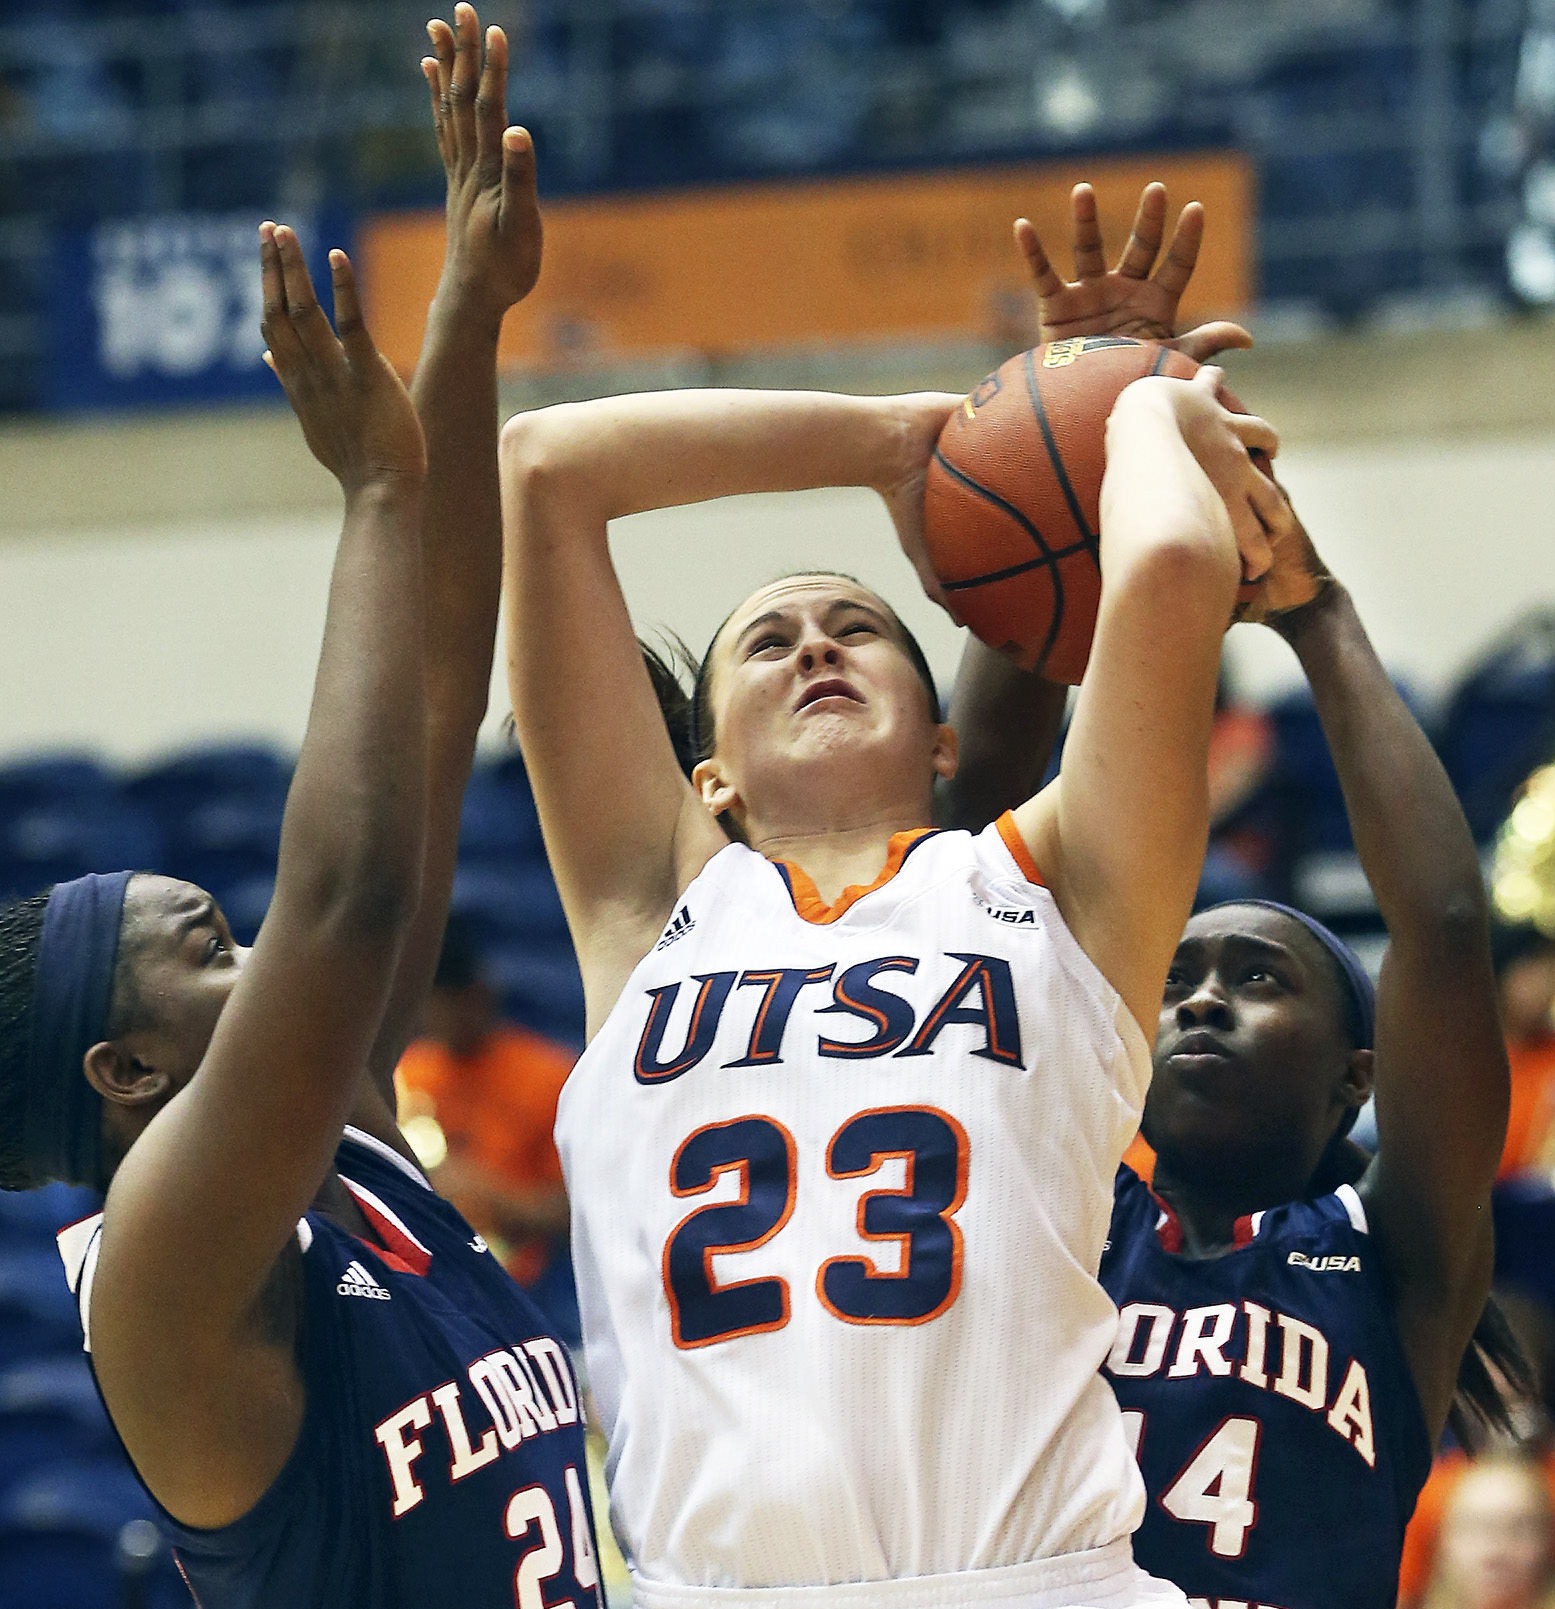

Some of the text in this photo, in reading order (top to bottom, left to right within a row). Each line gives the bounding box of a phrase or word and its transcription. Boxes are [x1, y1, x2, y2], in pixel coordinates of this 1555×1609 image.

[633, 952, 1027, 1085] UTSA
[662, 1104, 972, 1350] 23
[374, 1335, 587, 1520] FLORID
[1106, 1298, 1376, 1470] ORIDA
[1120, 1408, 1262, 1560] 4
